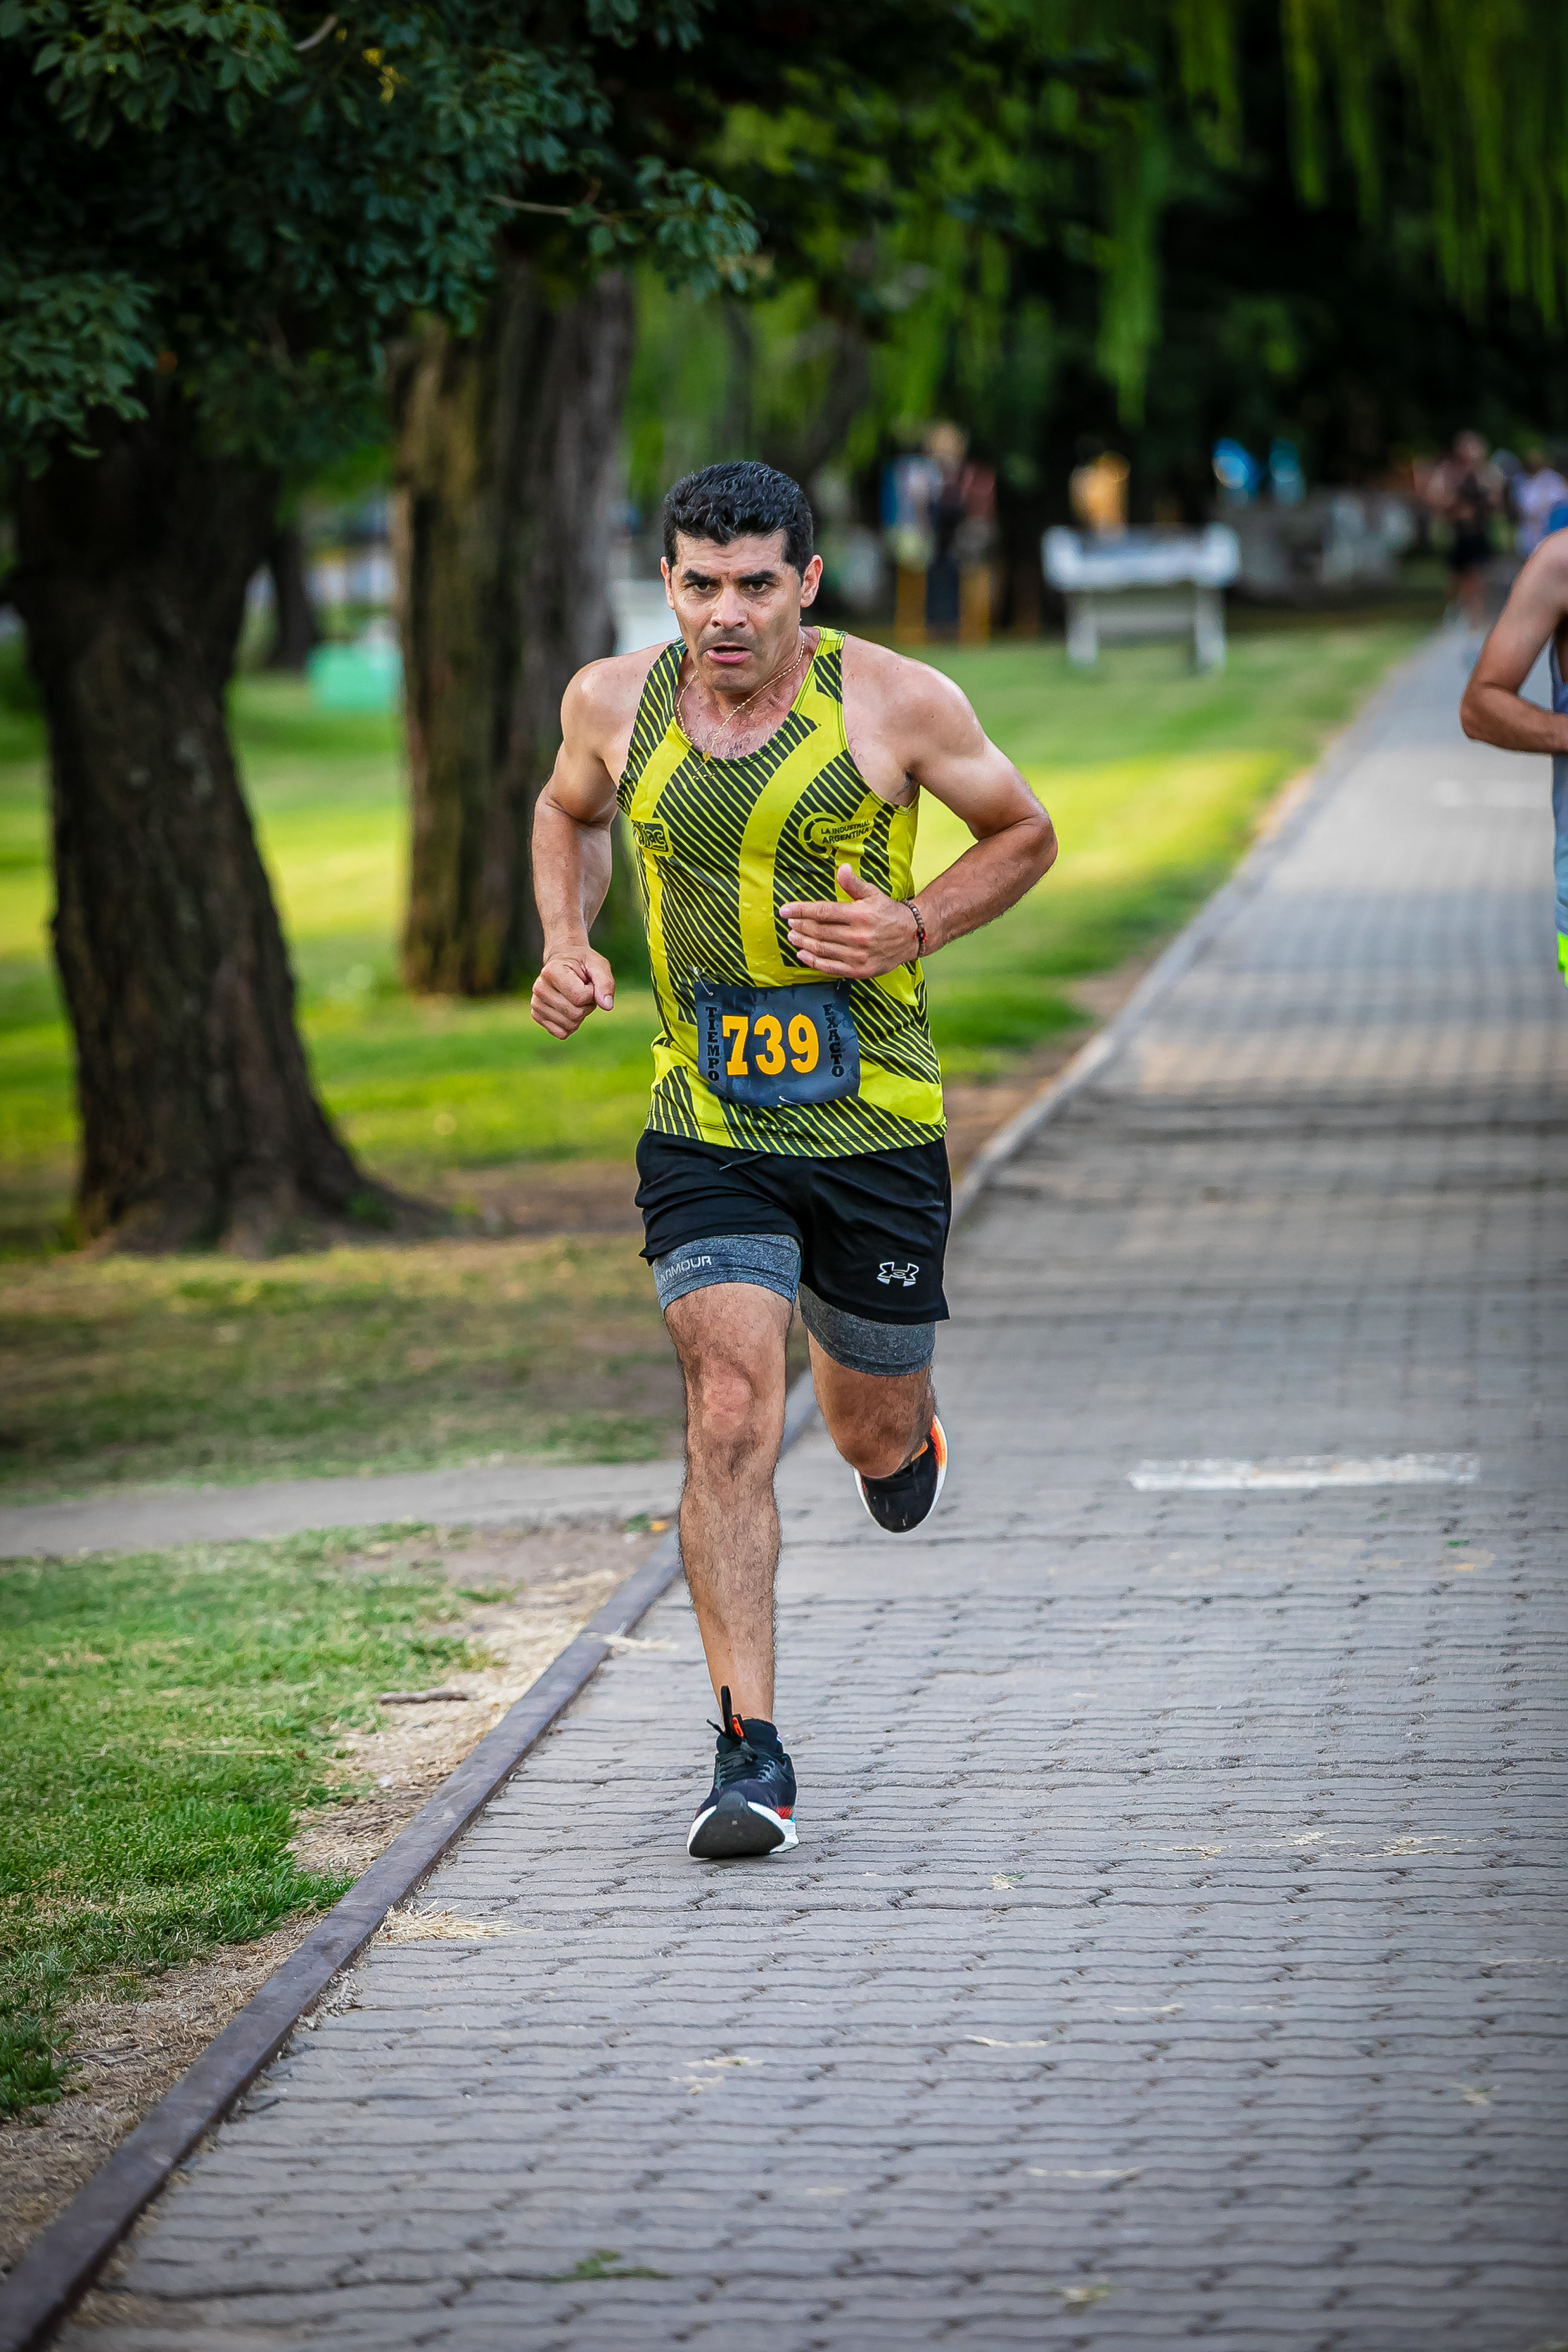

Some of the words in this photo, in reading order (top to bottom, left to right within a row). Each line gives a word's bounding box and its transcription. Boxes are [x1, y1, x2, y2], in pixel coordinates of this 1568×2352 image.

[822, 827, 869, 844] ARGENTINA
[832, 820, 870, 834] INDUSTRIAL
[705, 1005, 720, 1082] TIEMPO
[722, 1013, 820, 1076] 739
[822, 1003, 845, 1078] EXACTO
